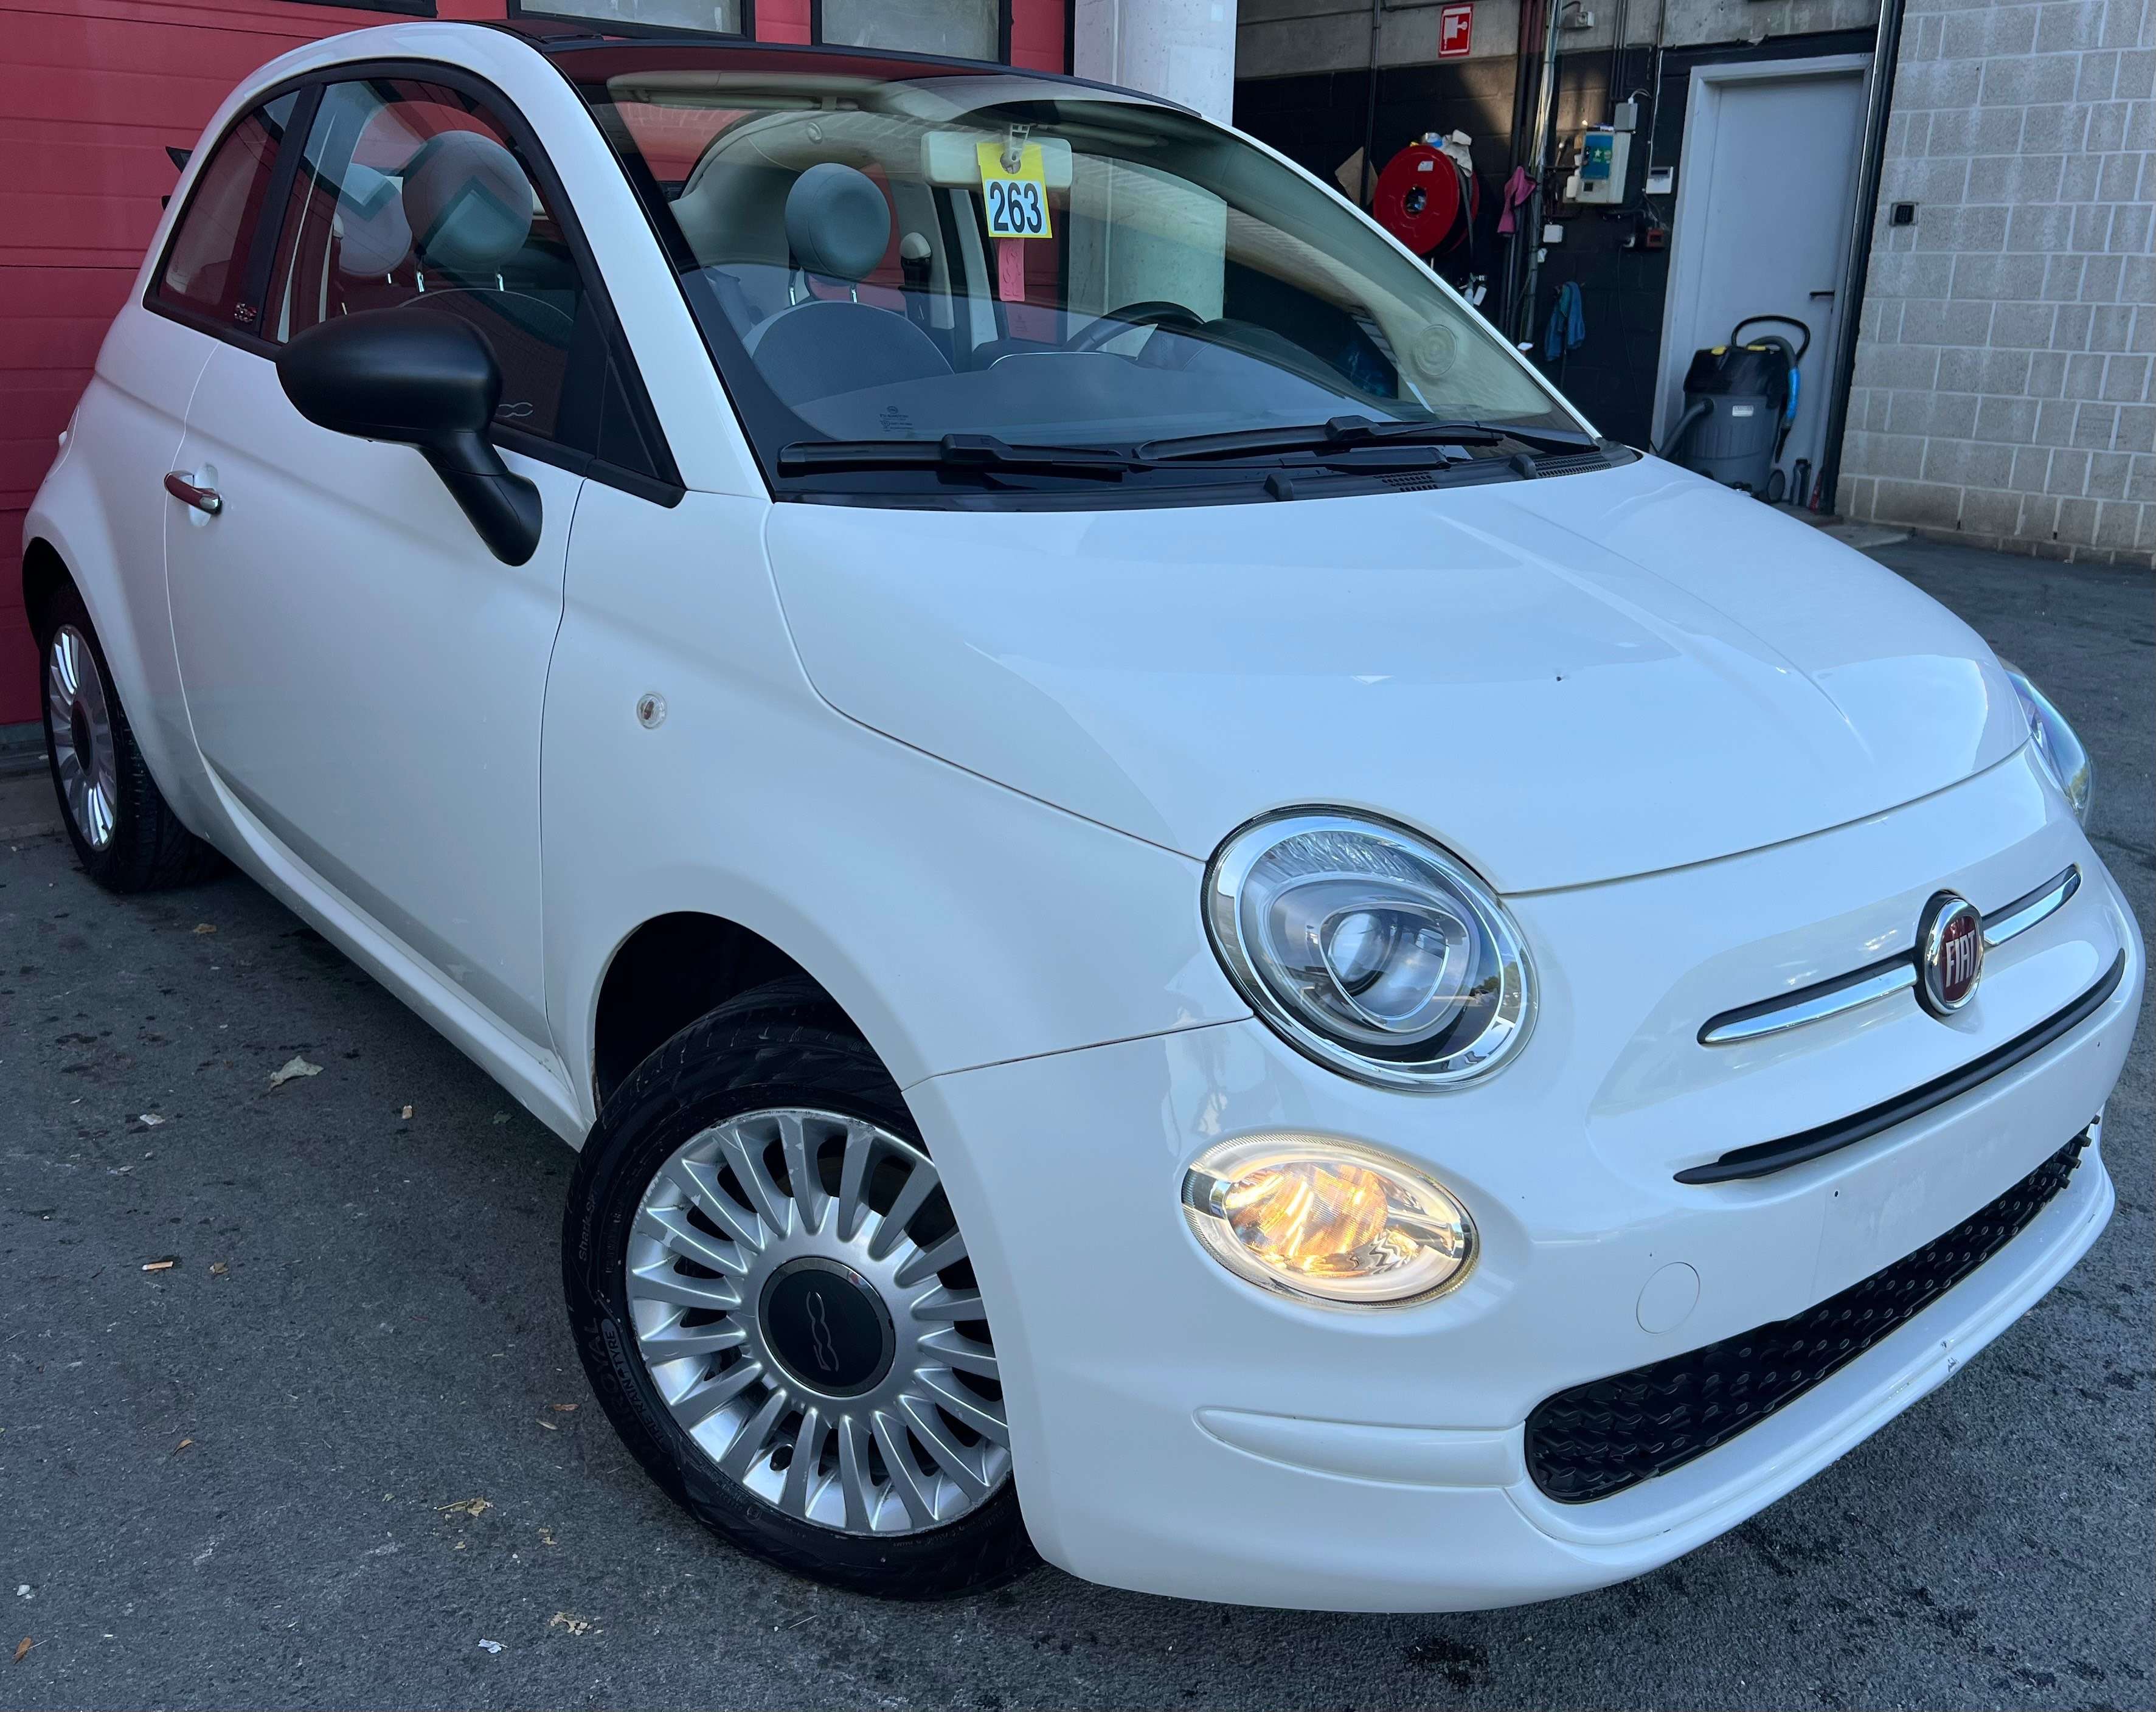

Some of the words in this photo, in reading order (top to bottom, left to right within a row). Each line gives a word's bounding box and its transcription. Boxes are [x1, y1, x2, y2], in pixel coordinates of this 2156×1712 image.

[990, 181, 1042, 234] 263
[1946, 929, 1975, 988] FIAT
[578, 1215, 592, 1262] Shark
[606, 1330, 624, 1368] TYRE
[806, 1291, 840, 1373] 500
[622, 1379, 646, 1413] RAIN
